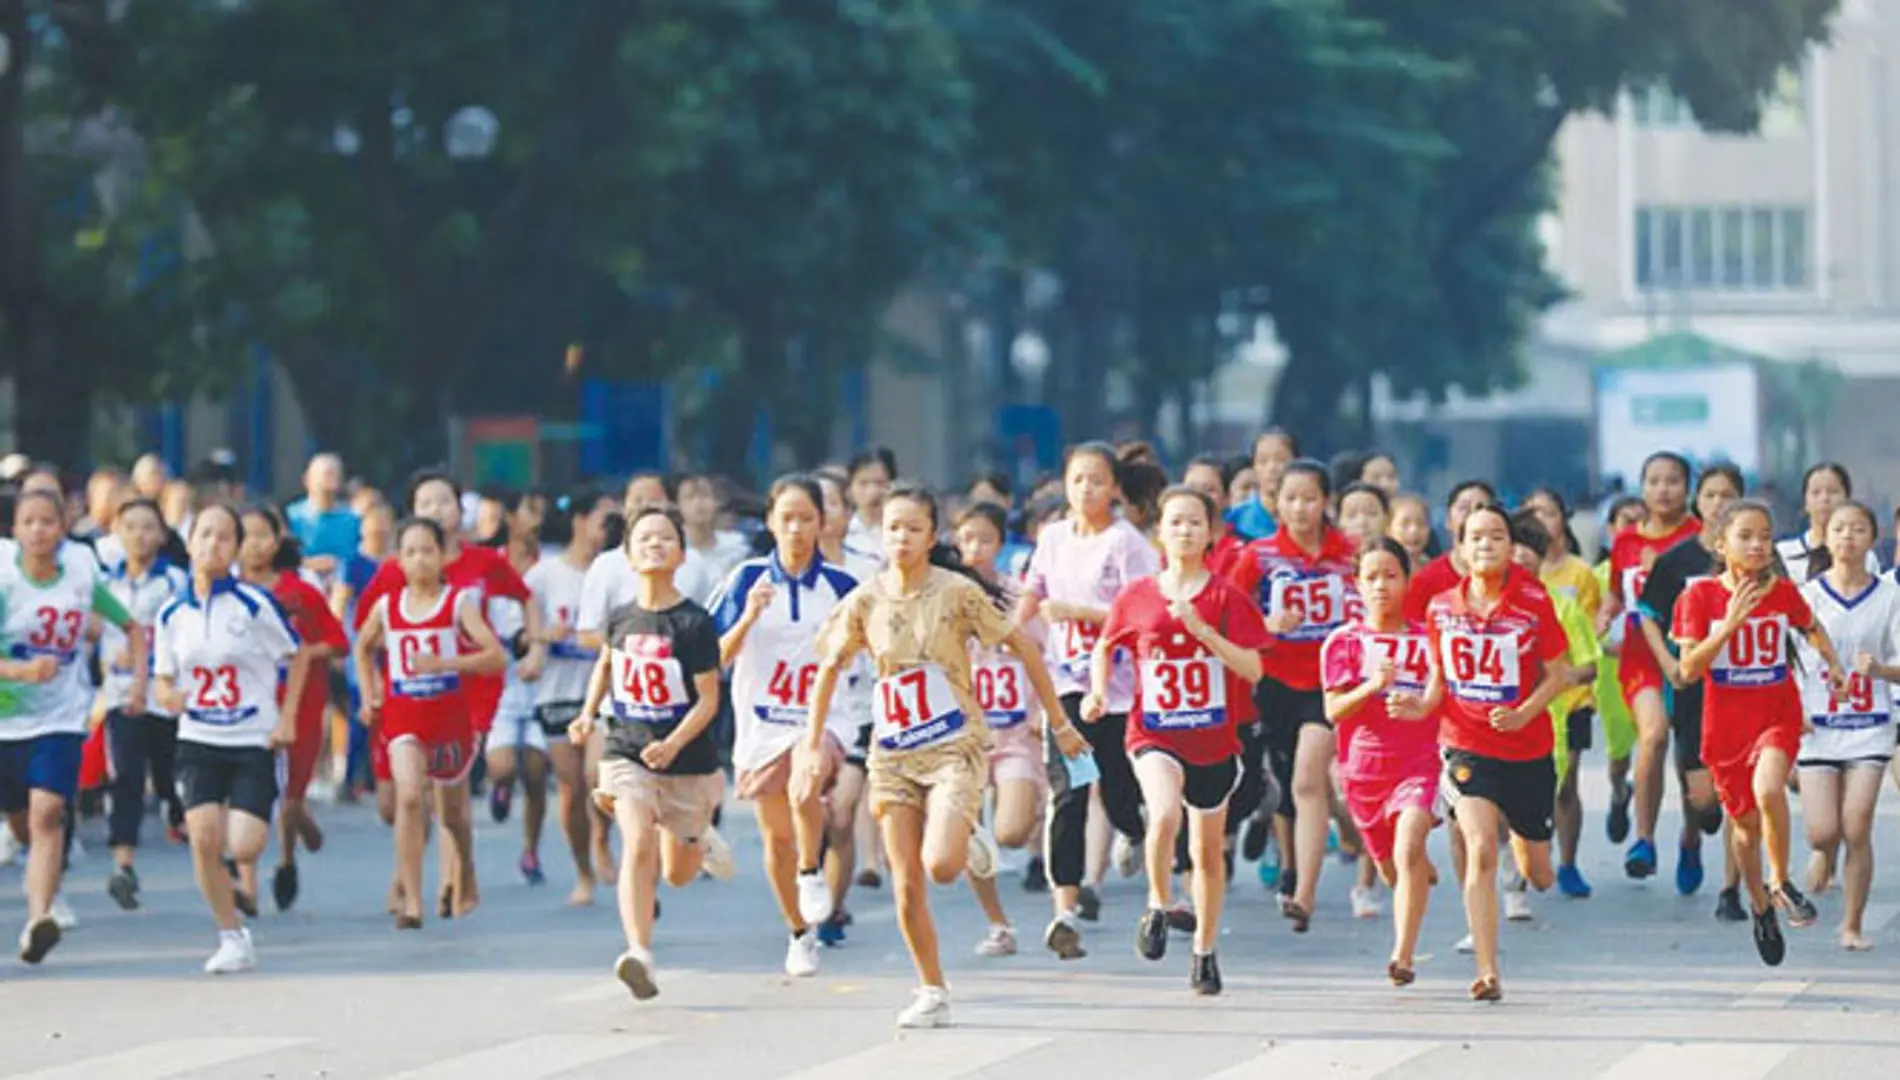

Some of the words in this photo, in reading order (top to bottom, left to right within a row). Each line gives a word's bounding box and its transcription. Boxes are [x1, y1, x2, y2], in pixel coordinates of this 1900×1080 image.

[1282, 580, 1332, 623] 65
[29, 605, 82, 650] 33
[1729, 619, 1779, 667] 09
[623, 657, 670, 705] 48
[1451, 636, 1504, 684] 64
[192, 663, 242, 708] 23
[881, 668, 932, 728] 47
[975, 665, 1018, 710] 03
[1154, 660, 1210, 710] 39
